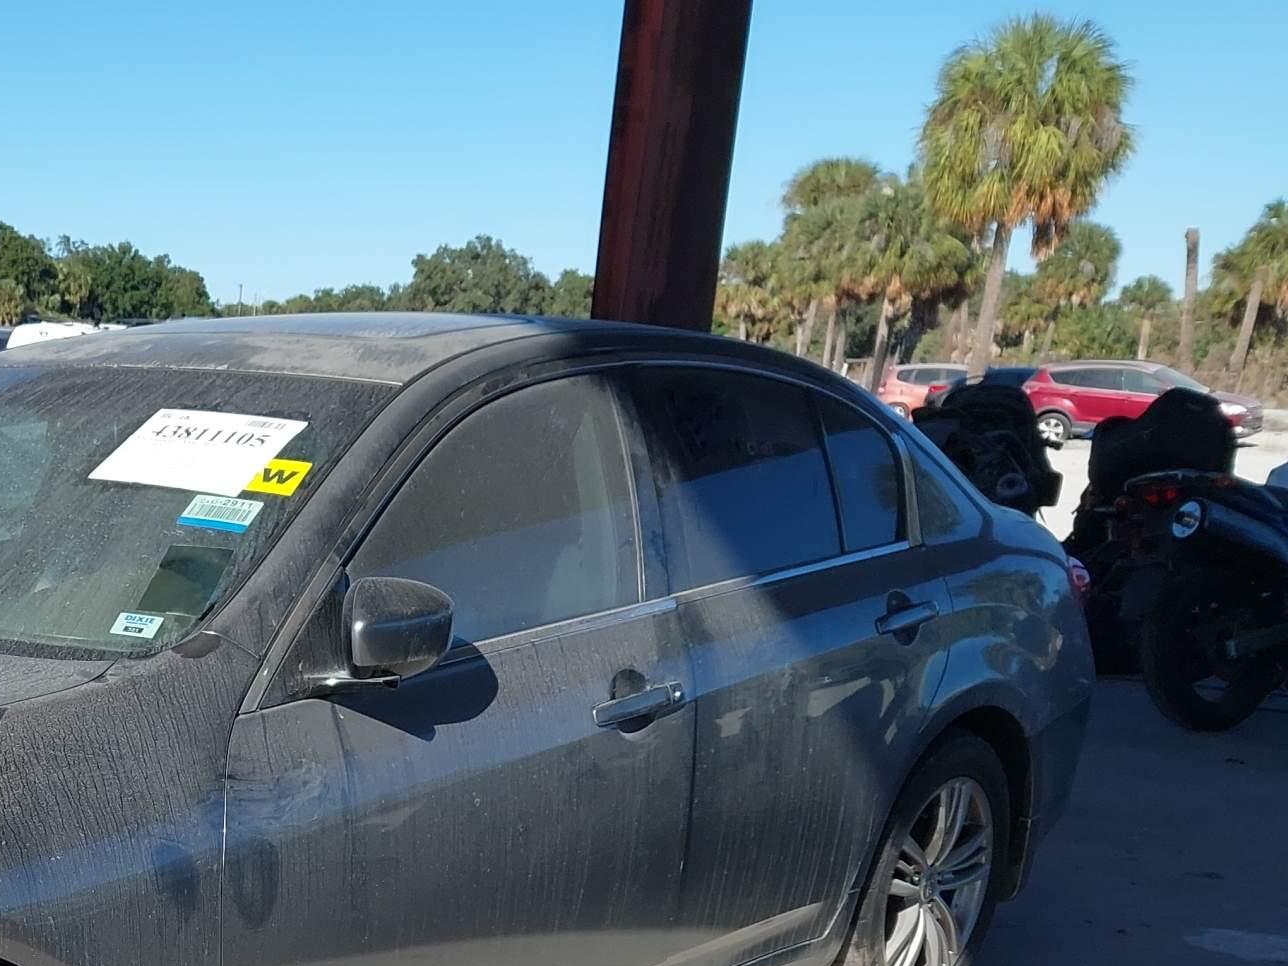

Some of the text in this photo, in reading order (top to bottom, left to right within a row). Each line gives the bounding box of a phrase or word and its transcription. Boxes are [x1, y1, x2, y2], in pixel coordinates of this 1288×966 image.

[151, 424, 273, 448] 43811105
[261, 467, 300, 485] W
[124, 614, 156, 625] DIXIE
